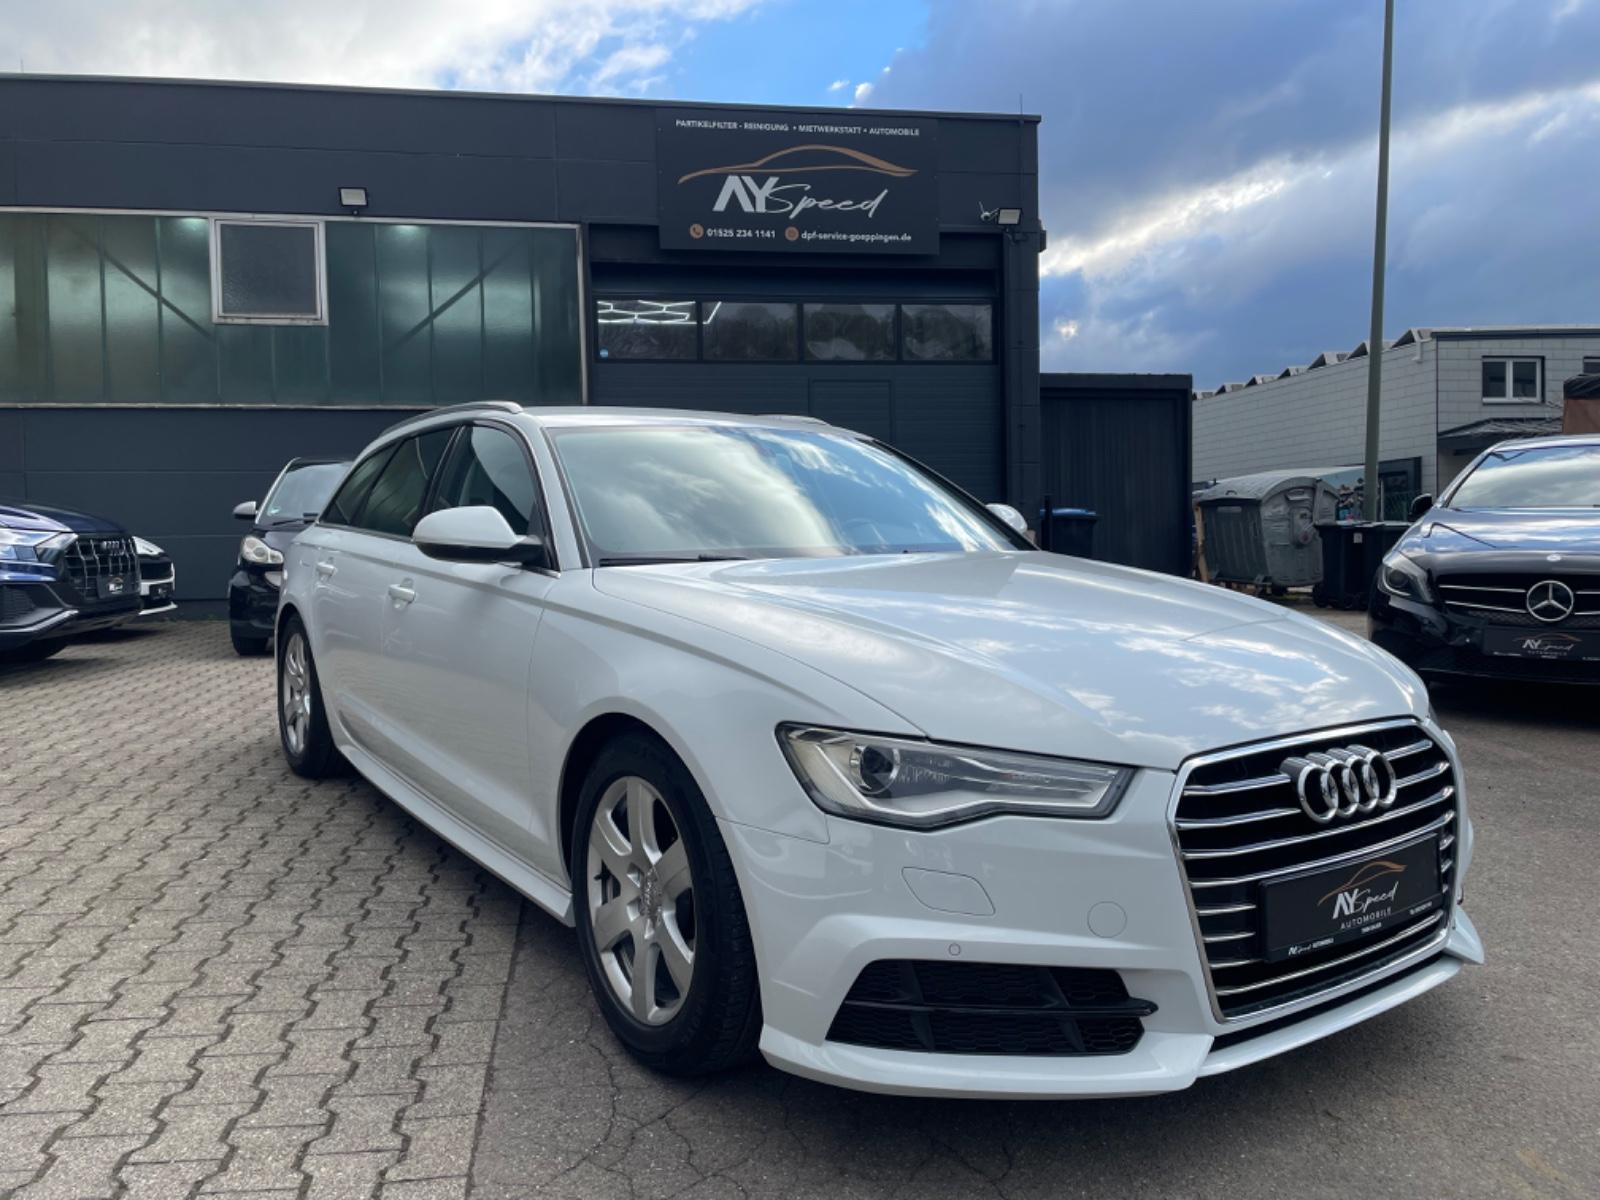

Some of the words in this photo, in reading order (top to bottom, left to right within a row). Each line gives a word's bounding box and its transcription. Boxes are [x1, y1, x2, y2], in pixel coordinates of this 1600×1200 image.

[675, 120, 738, 129] PARTIKELFILTER
[744, 122, 789, 131] REINIGUNG
[799, 125, 861, 135] MIETWERKSTATT
[869, 127, 919, 136] AUTOMOBILE
[763, 184, 888, 219] Speed
[706, 228, 734, 238] 01525
[736, 230, 753, 239] 234
[755, 230, 776, 239] 1141
[801, 231, 911, 242] dpf-service-goeppingen.de
[1340, 907, 1392, 930] AUTOMOBILE
